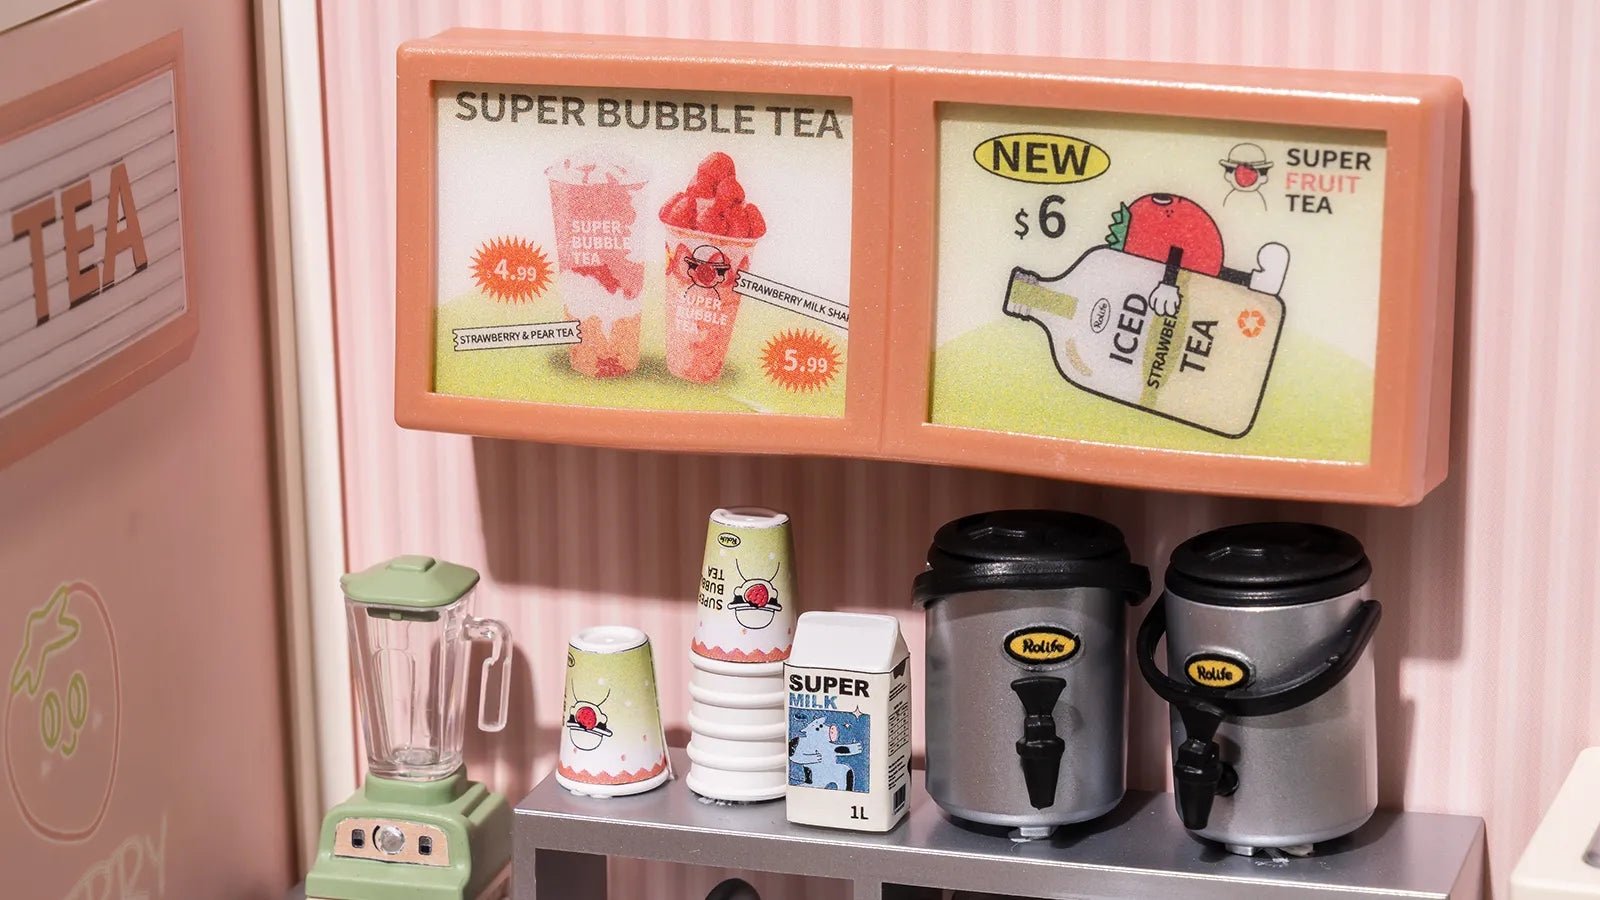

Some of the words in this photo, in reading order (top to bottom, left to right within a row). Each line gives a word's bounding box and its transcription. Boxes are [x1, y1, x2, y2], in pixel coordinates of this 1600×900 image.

[455, 91, 585, 127] SUPER
[598, 99, 755, 135] BUBBLE
[767, 106, 843, 139] TEA
[993, 139, 1091, 176] NEW
[1286, 147, 1371, 170] SUPER
[1285, 172, 1361, 194] FRUIT
[1286, 194, 1333, 215] TEA
[572, 219, 621, 234] SUPER
[12, 163, 147, 326] TEA
[572, 236, 631, 250] BUBBLE
[573, 251, 601, 266] TEA
[740, 278, 804, 306] STRAWBERRY
[803, 299, 826, 315] MILK
[460, 331, 520, 345] STRAWBERRY
[522, 330, 529, 340] &
[531, 329, 555, 340] PEAR
[556, 328, 574, 338] TEA
[1109, 293, 1149, 366] ICED
[1179, 319, 1219, 373] TEA
[707, 565, 725, 581] TEA
[1022, 638, 1066, 656] Rolife
[1196, 664, 1234, 682] Rolife
[789, 673, 870, 698] SUPER
[789, 692, 838, 709] MILK
[850, 805, 869, 820] 1L
